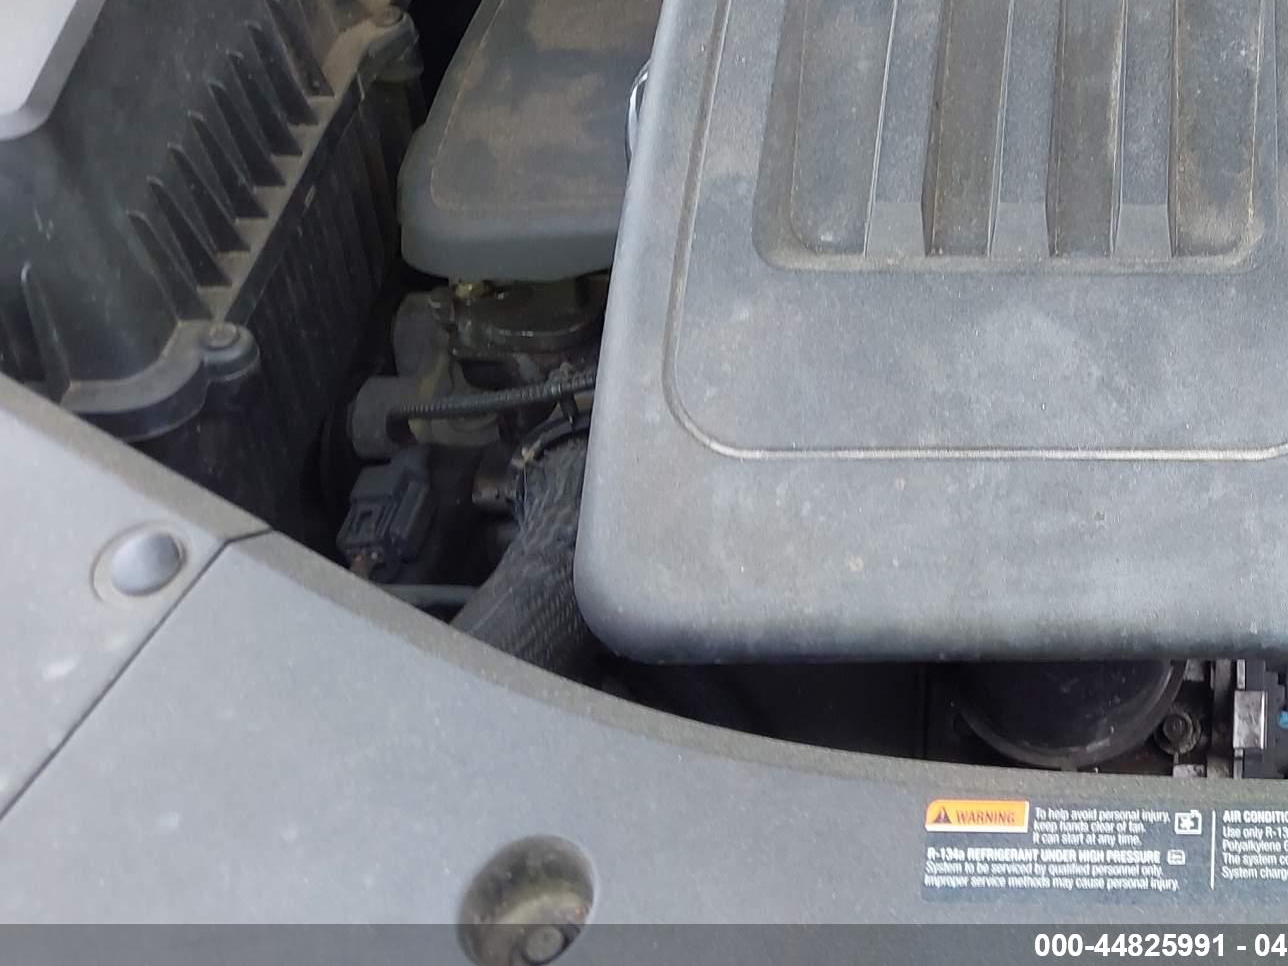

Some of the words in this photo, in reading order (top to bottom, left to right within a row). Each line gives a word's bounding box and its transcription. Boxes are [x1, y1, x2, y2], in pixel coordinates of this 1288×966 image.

[957, 810, 1015, 823] WARNING
[1223, 810, 1241, 823] AIR
[1223, 826, 1241, 837] Use
[1243, 827, 1262, 839] only
[928, 849, 964, 861] R-134a
[967, 849, 1038, 861] REFRIGERANT
[1041, 849, 1076, 862] UNDER
[1079, 850, 1104, 862] HIGH
[1107, 850, 1160, 863] PRESSURE
[1223, 853, 1240, 864] The
[1243, 854, 1276, 866] system
